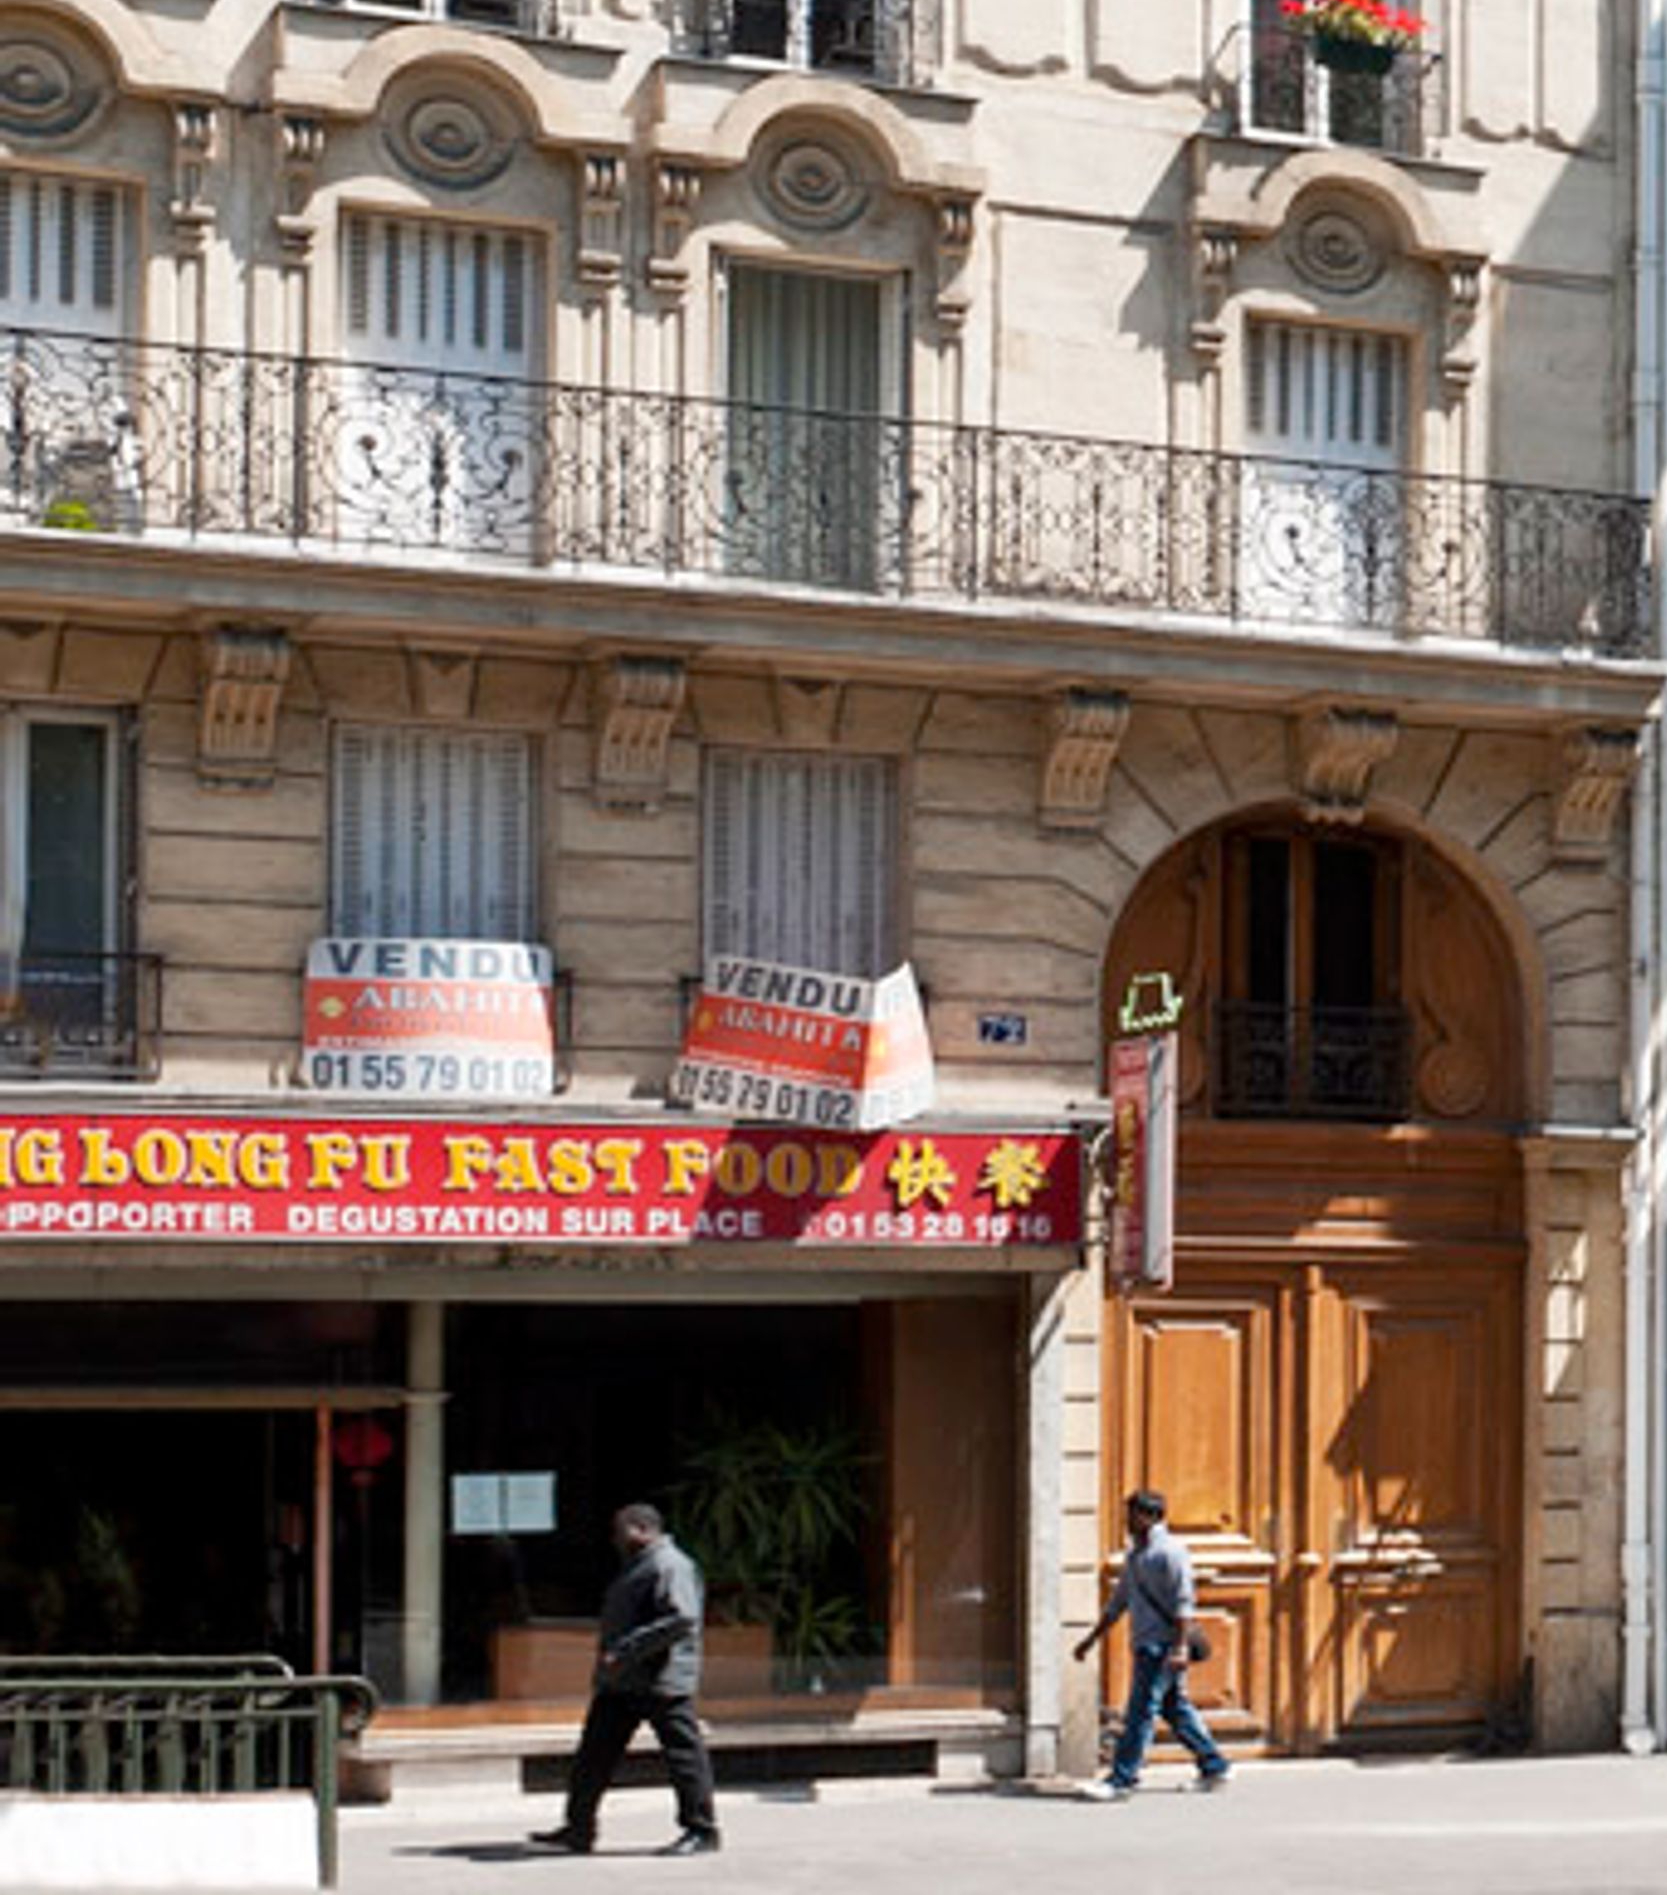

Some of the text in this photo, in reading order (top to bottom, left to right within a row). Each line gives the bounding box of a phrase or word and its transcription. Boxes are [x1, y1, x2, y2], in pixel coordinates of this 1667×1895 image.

[328, 942, 541, 982] VENDU
[717, 962, 861, 1015] VENDU
[312, 1053, 349, 1088] 01
[361, 1054, 405, 1090] 55
[416, 1056, 460, 1090] 79
[306, 1132, 412, 1192] FU
[442, 1134, 644, 1195] FAST
[662, 1138, 864, 1196] FOOD
[288, 1204, 548, 1234] DEGUSTATION
[561, 1210, 634, 1235] SUR
[647, 1211, 761, 1237] PLACE
